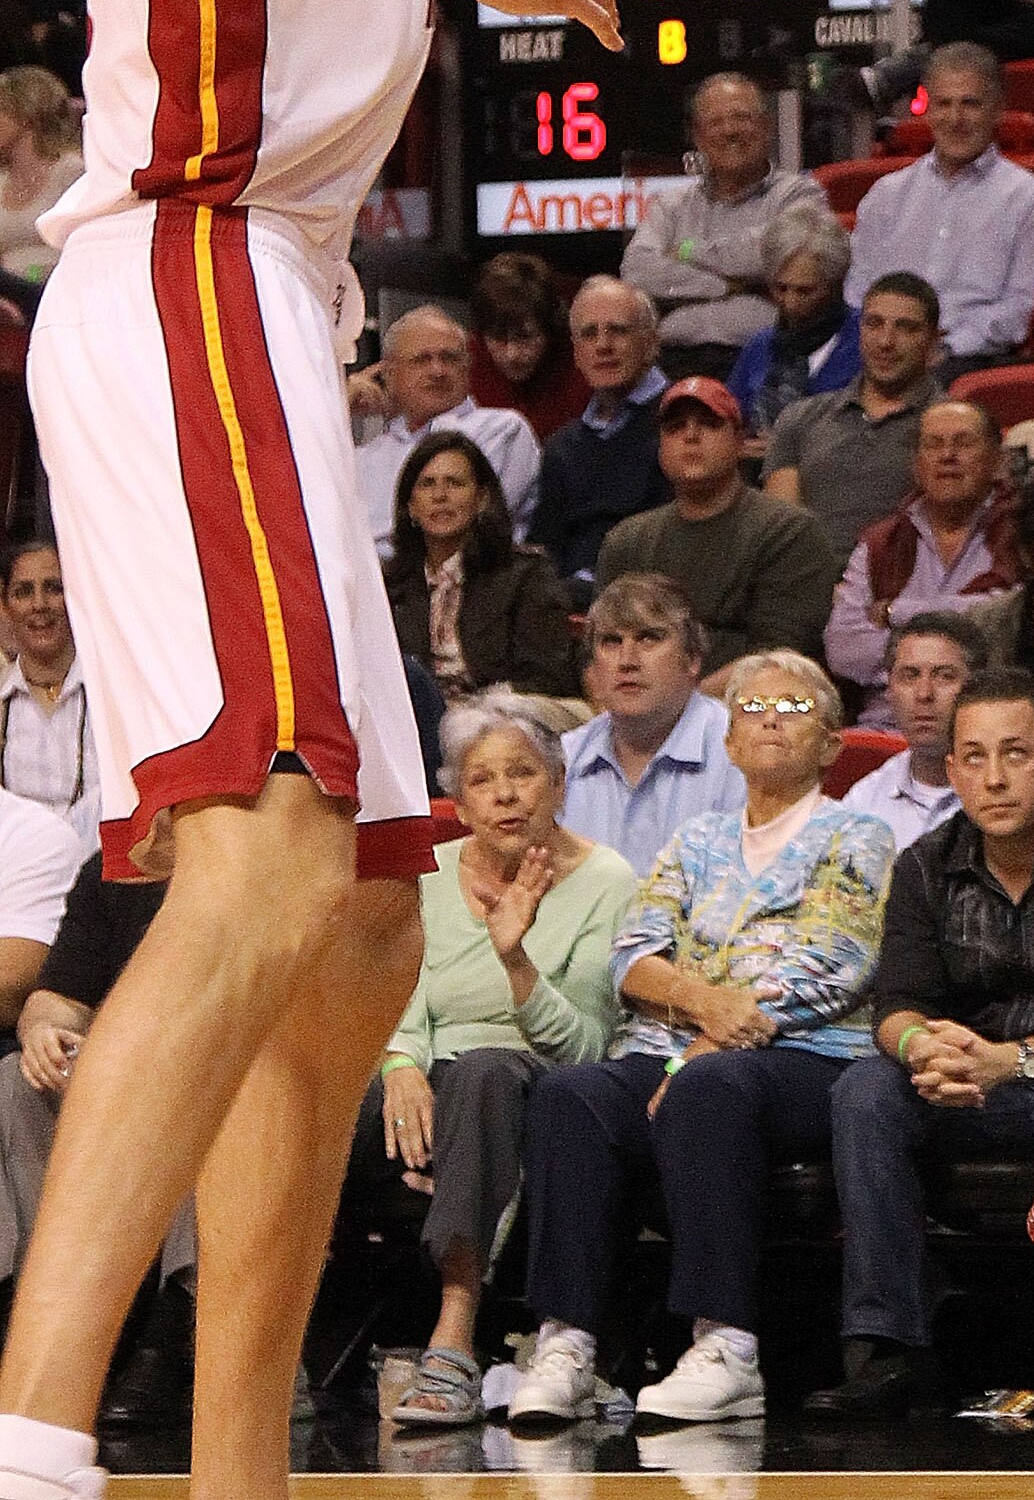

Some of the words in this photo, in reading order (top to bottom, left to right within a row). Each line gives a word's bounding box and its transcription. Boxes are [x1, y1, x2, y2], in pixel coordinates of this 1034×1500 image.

[500, 30, 566, 63] HEAT
[536, 82, 606, 161] 16
[502, 177, 662, 232] Ameri
